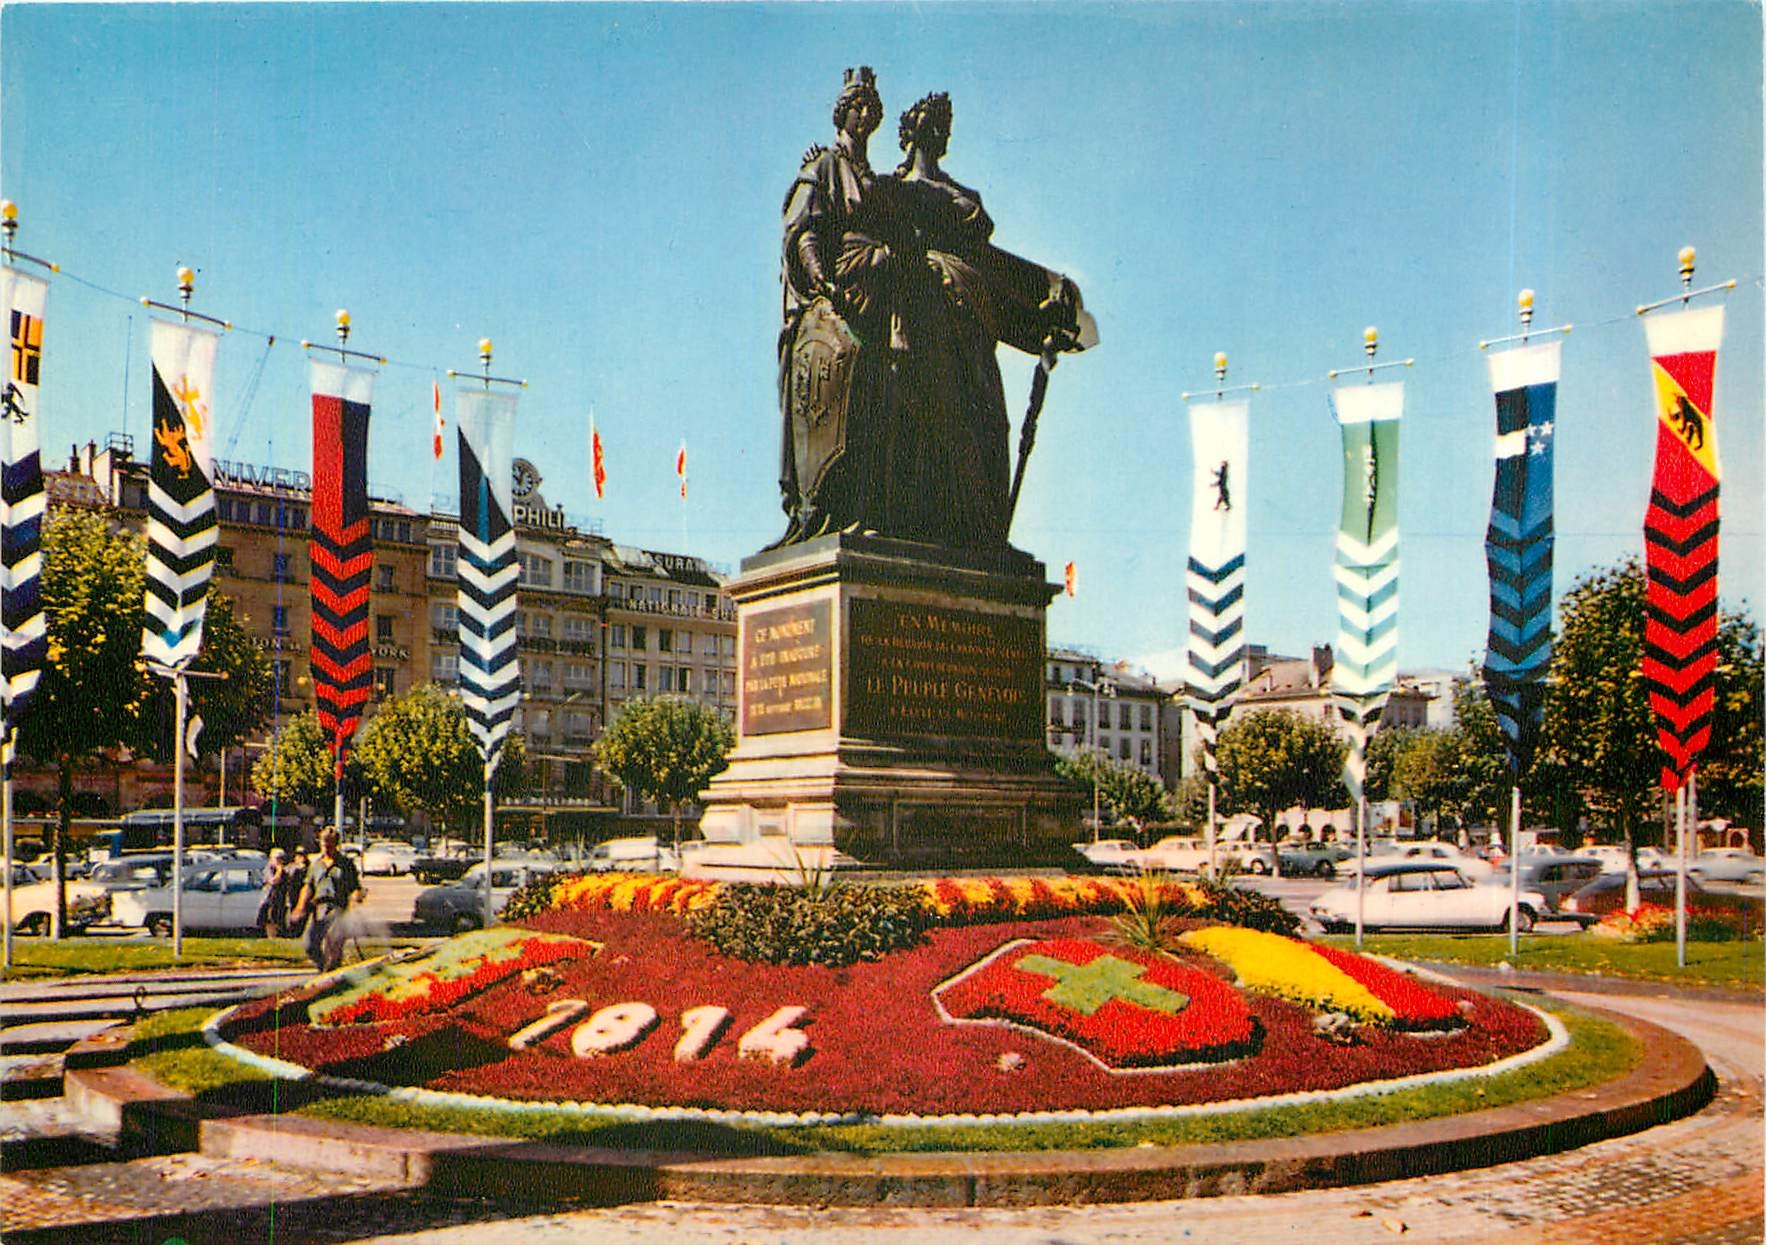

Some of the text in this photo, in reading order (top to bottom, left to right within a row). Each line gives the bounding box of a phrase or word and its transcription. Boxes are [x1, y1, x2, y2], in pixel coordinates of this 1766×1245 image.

[208, 458, 311, 497] NIVER
[513, 505, 563, 530] PHILI
[653, 554, 694, 571] SURA
[509, 999, 808, 1066] 1814
